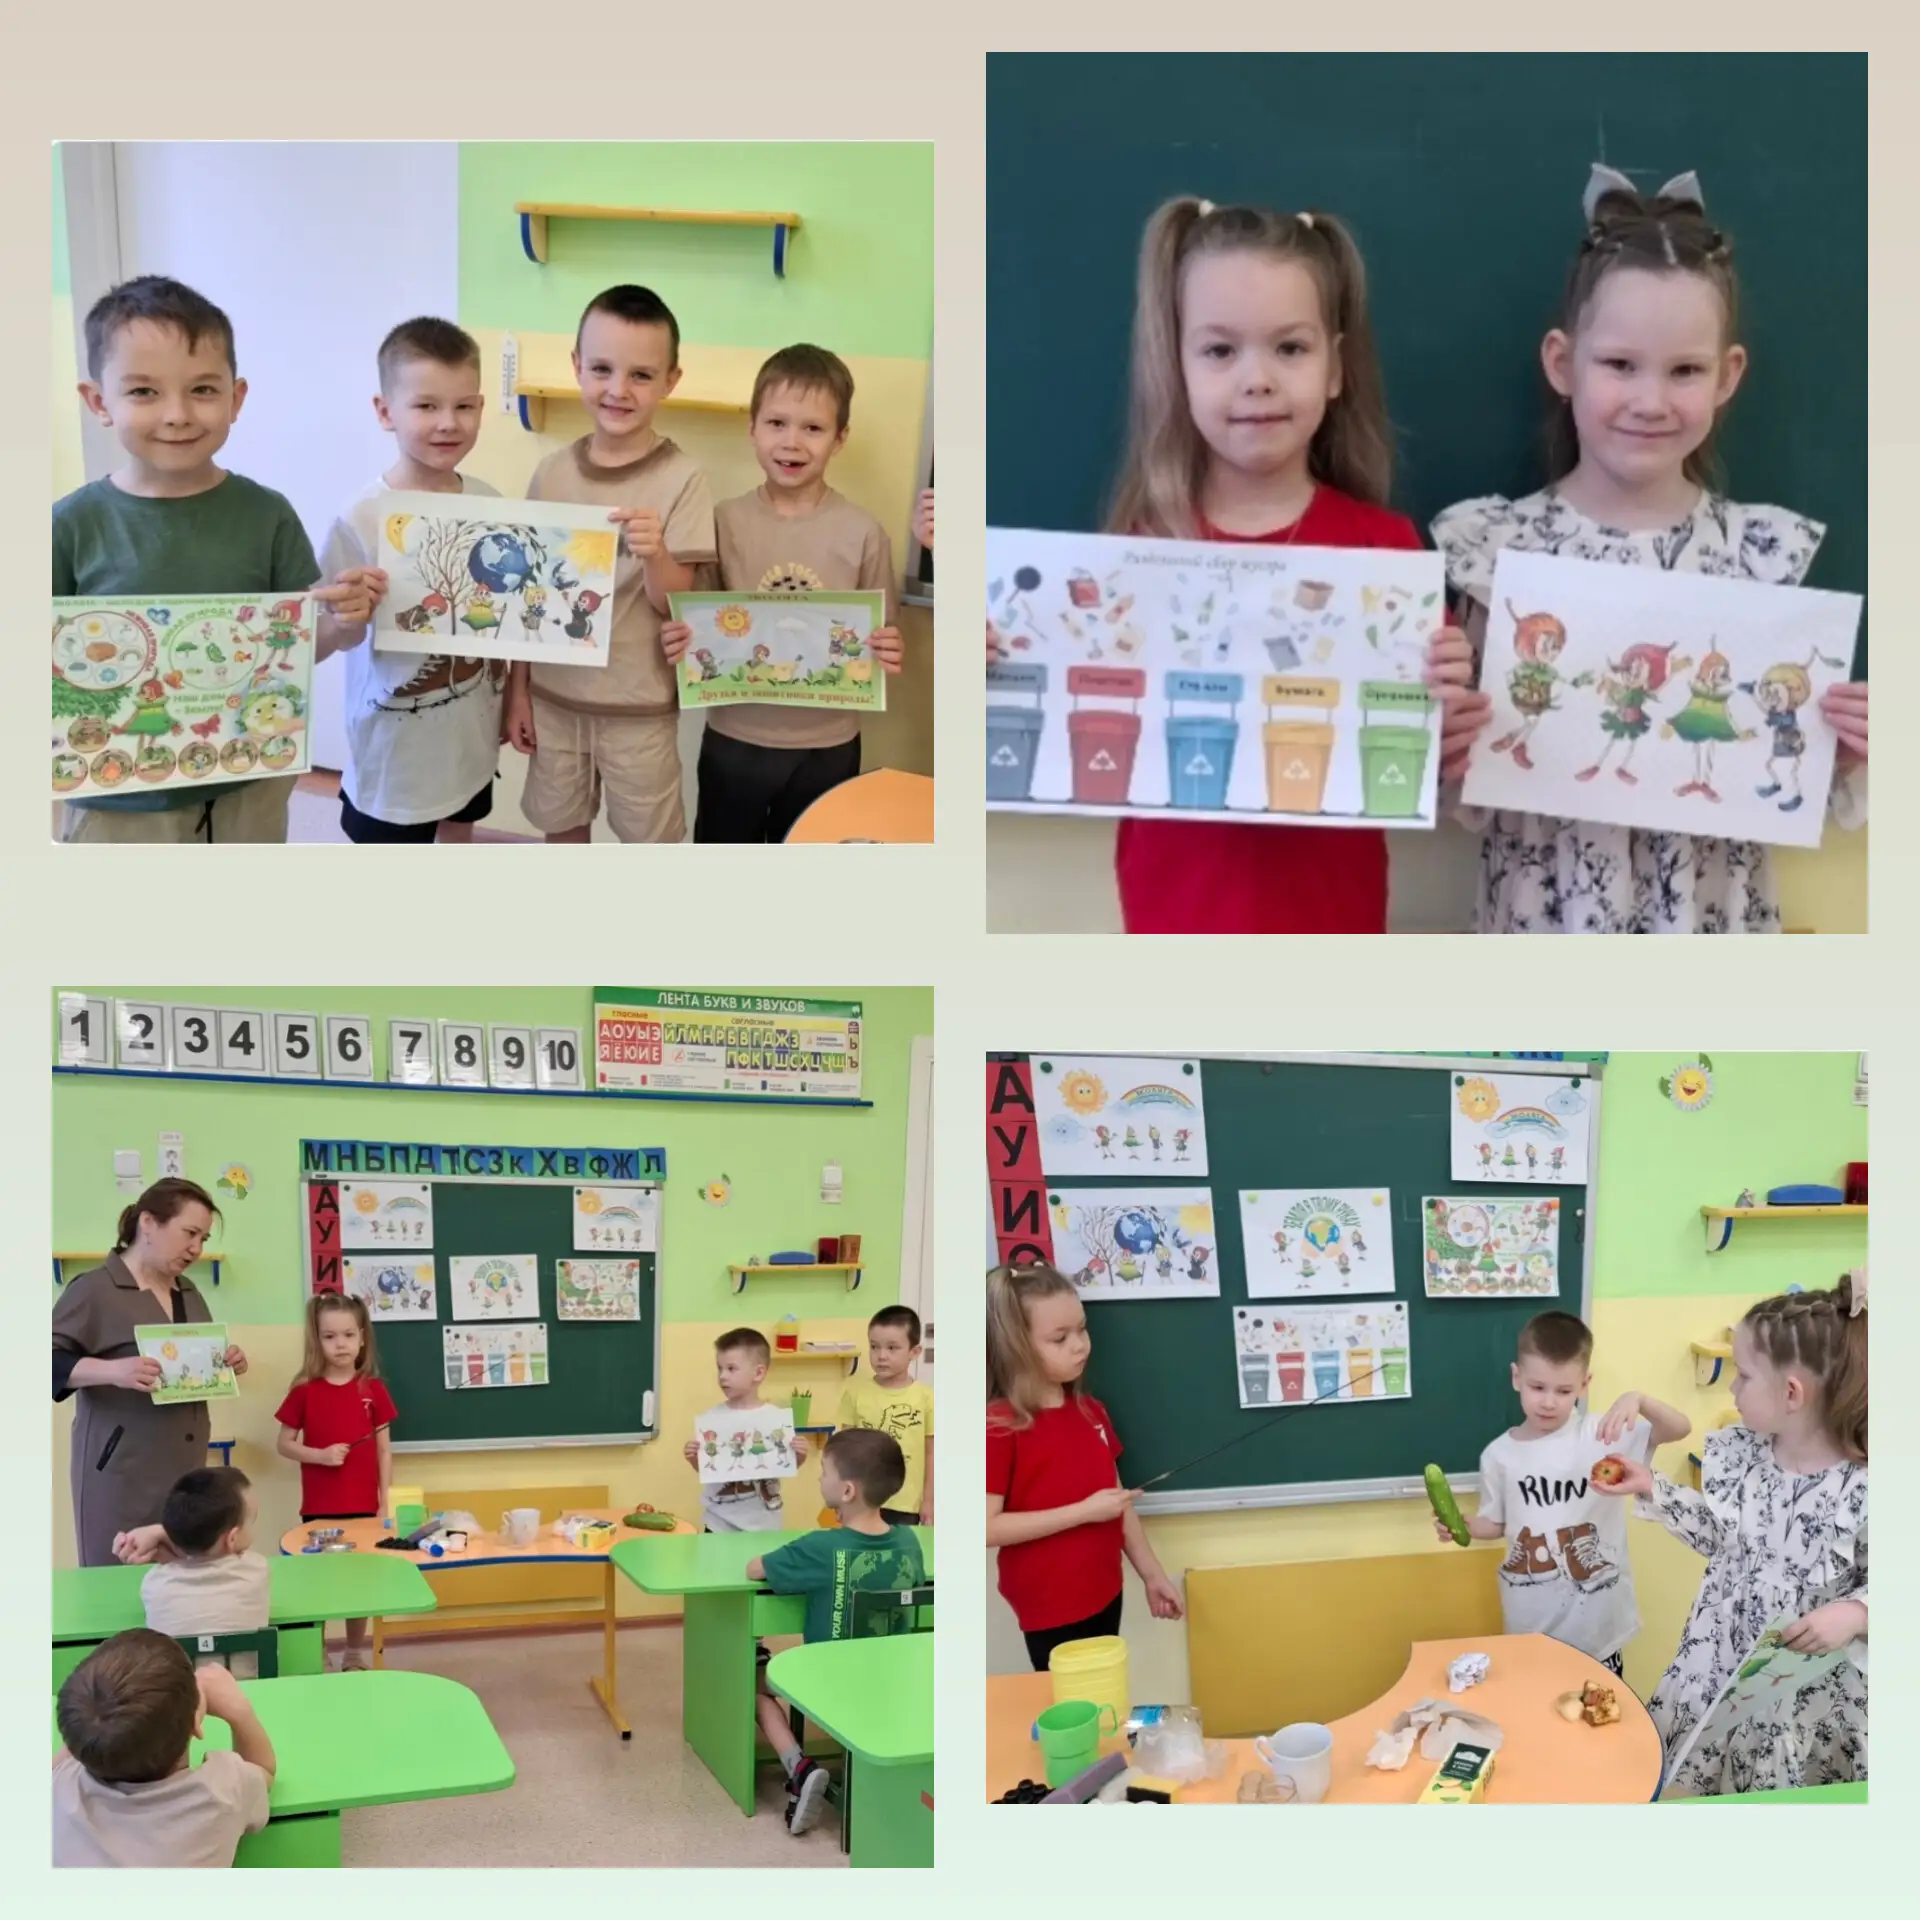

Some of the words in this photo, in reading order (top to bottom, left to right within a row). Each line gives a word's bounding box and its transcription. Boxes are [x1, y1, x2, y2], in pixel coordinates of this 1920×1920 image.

[657, 991, 700, 1007] ЛЕНТА
[703, 996, 738, 1009] БУКВ
[741, 999, 752, 1010] И
[755, 998, 806, 1013] ЗВУКОВ
[70, 1010, 90, 1047] 1
[128, 1014, 155, 1050] 2
[183, 1017, 209, 1053] 3
[228, 1020, 255, 1056] 4
[286, 1024, 310, 1059] 5
[338, 1027, 362, 1062] 6
[399, 1031, 423, 1063] 7
[454, 1034, 477, 1067] 8
[502, 1036, 526, 1069] 9
[546, 1039, 576, 1071] 10
[1518, 1475, 1589, 1507] RUN
[836, 1549, 846, 1583] MUSE
[834, 1585, 845, 1610] OWN
[832, 1610, 843, 1639] YOUR
